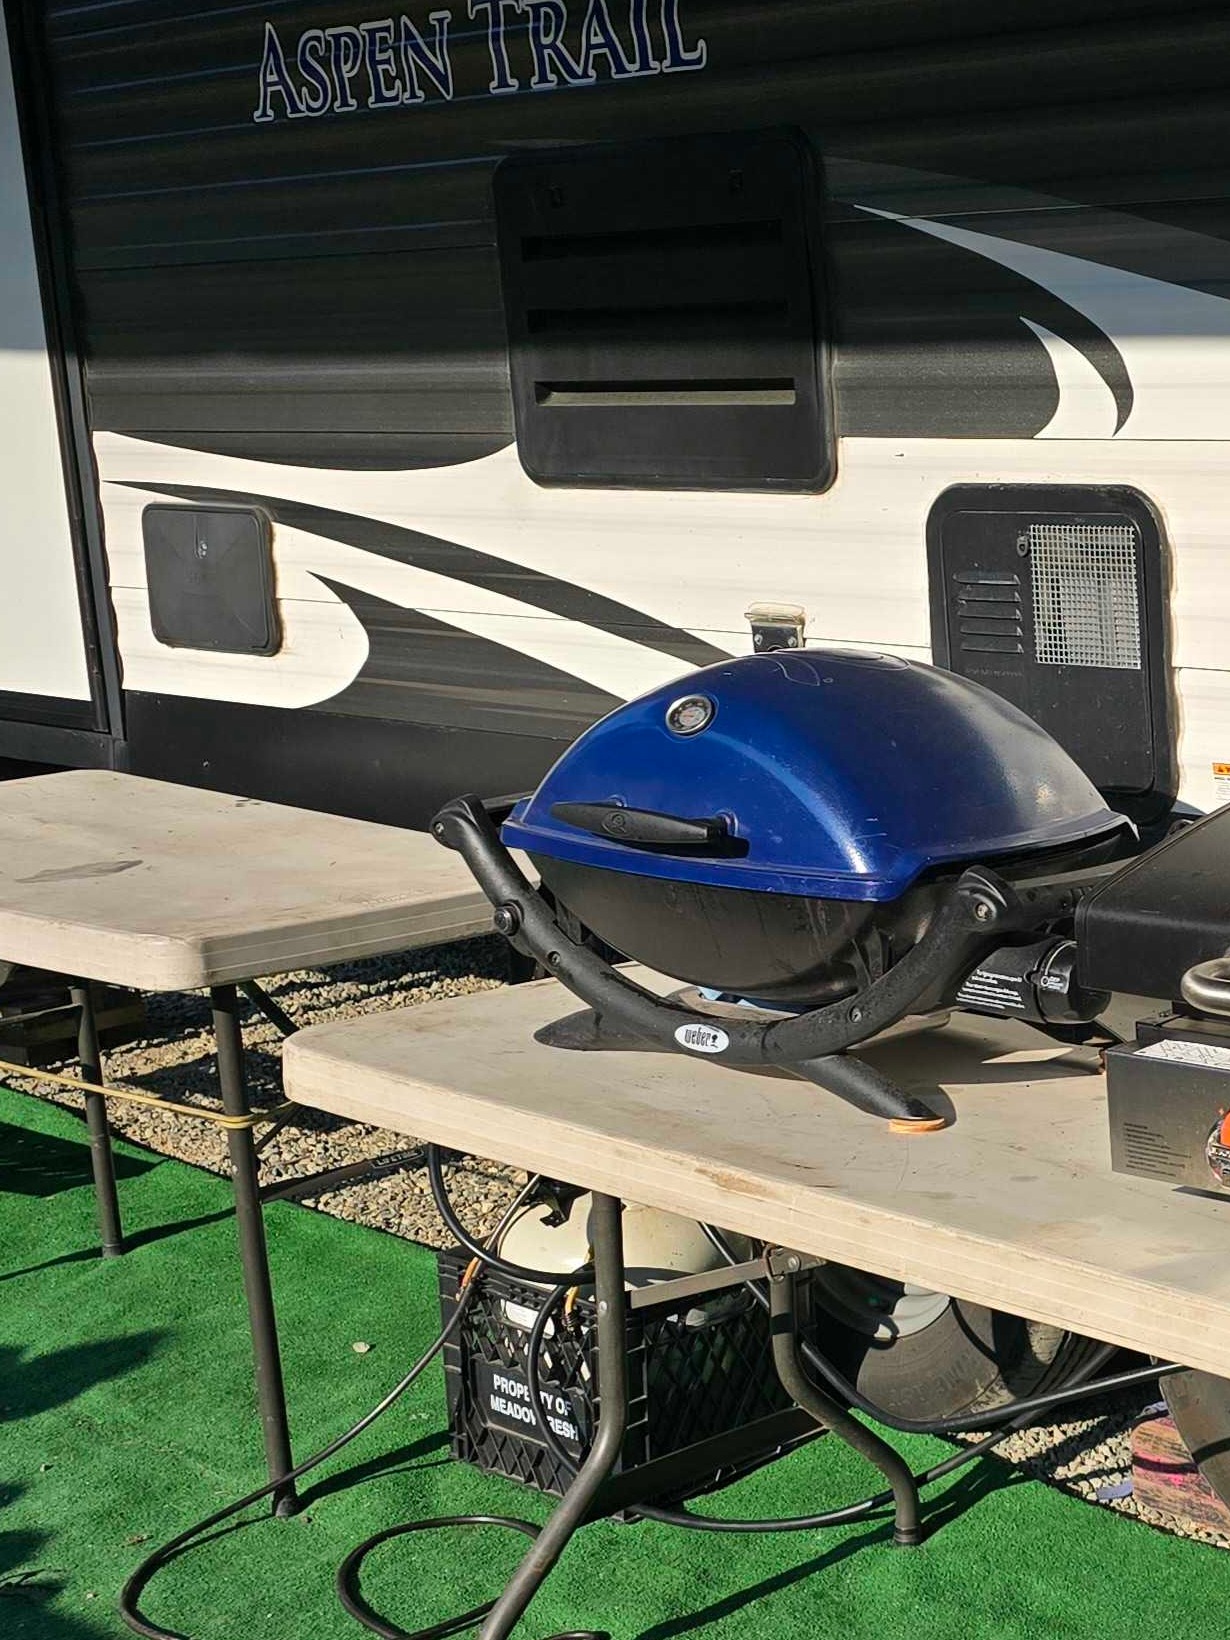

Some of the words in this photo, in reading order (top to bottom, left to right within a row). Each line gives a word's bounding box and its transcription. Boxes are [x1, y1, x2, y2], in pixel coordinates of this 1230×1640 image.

[253, 10, 454, 123] ASPEN
[467, 0, 707, 94] TRAIL
[684, 1026, 712, 1047] weber
